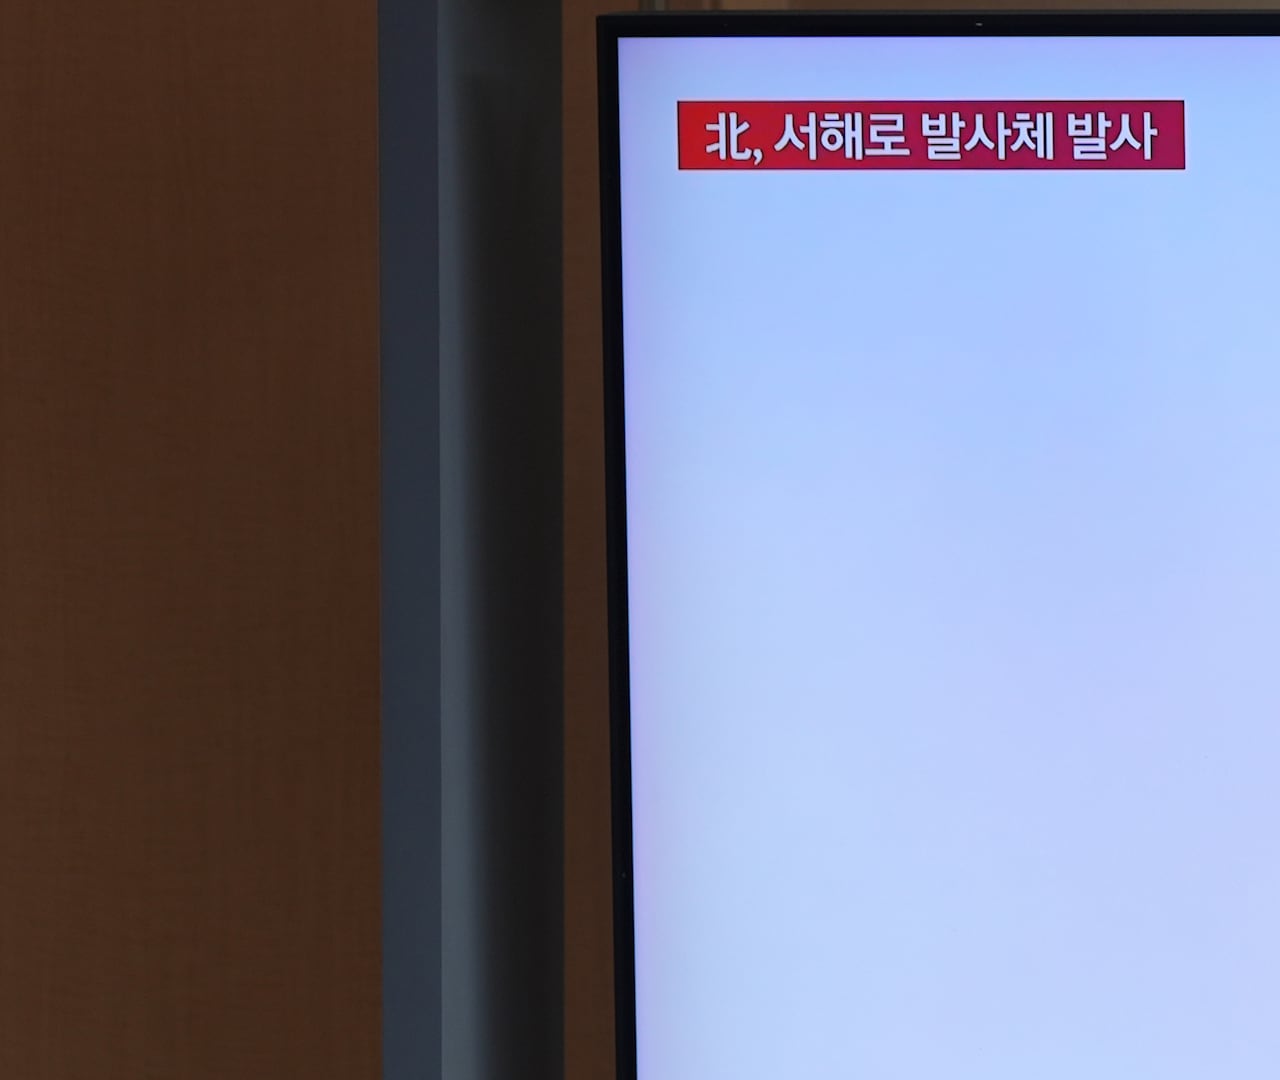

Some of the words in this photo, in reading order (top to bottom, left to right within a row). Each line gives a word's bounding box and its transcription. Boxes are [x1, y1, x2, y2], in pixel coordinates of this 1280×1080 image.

[705, 112, 763, 165] 北,
[774, 112, 911, 161] 서해로
[921, 111, 1055, 161] 발사체
[1067, 111, 1158, 161] 발사
